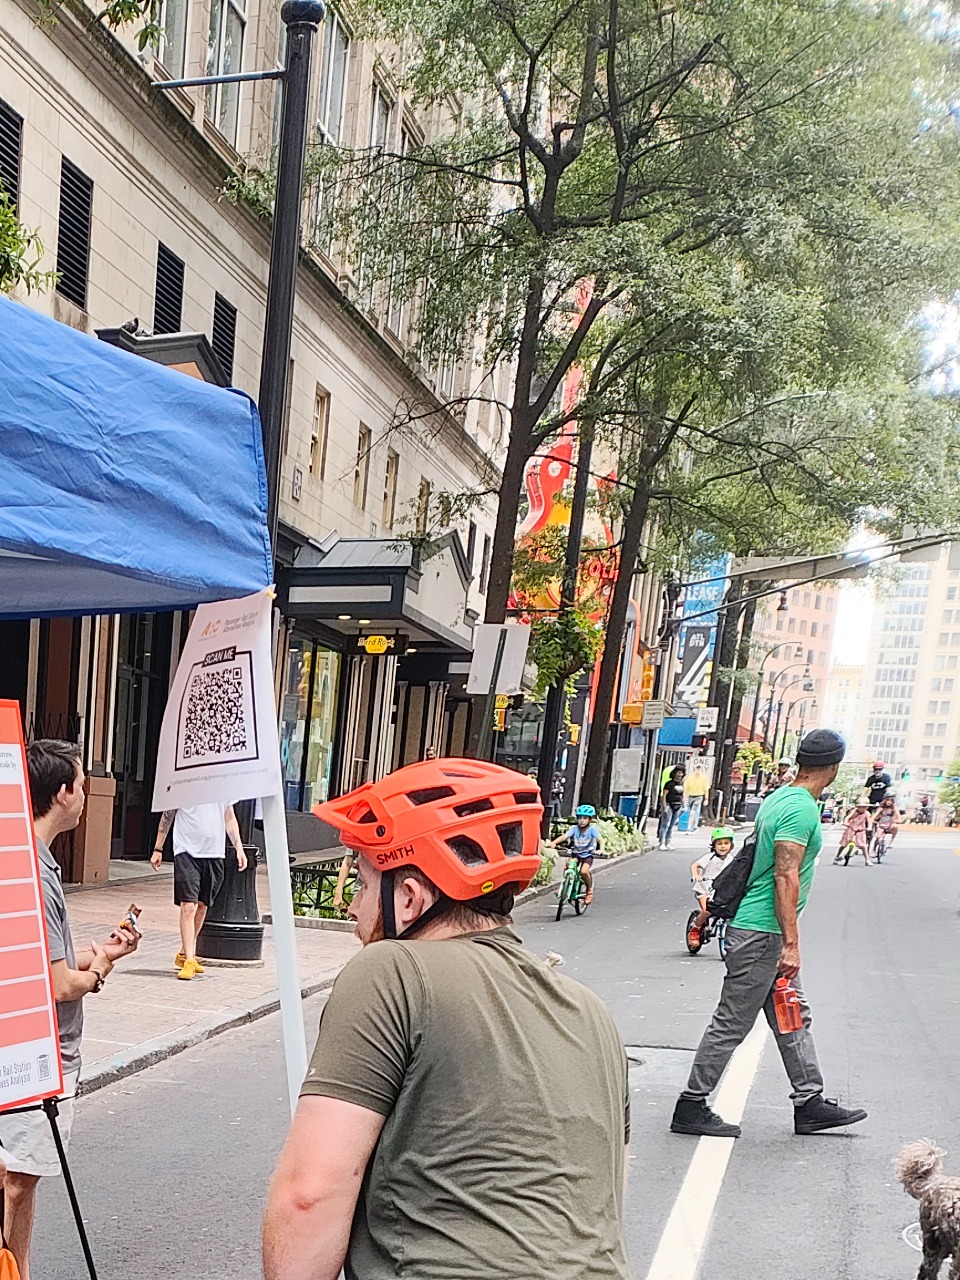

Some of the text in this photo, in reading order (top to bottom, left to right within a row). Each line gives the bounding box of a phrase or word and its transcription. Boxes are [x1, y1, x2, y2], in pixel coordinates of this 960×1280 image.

[687, 586, 719, 600] LEASE
[357, 636, 395, 648] Hard Rock
[205, 648, 235, 665] SCAN ME
[10, 760, 17, 770] by
[376, 845, 415, 865] SMITH
[2, 1064, 13, 1076] Rail
[14, 1061, 32, 1074] Station
[10, 1073, 31, 1087] Analysis
